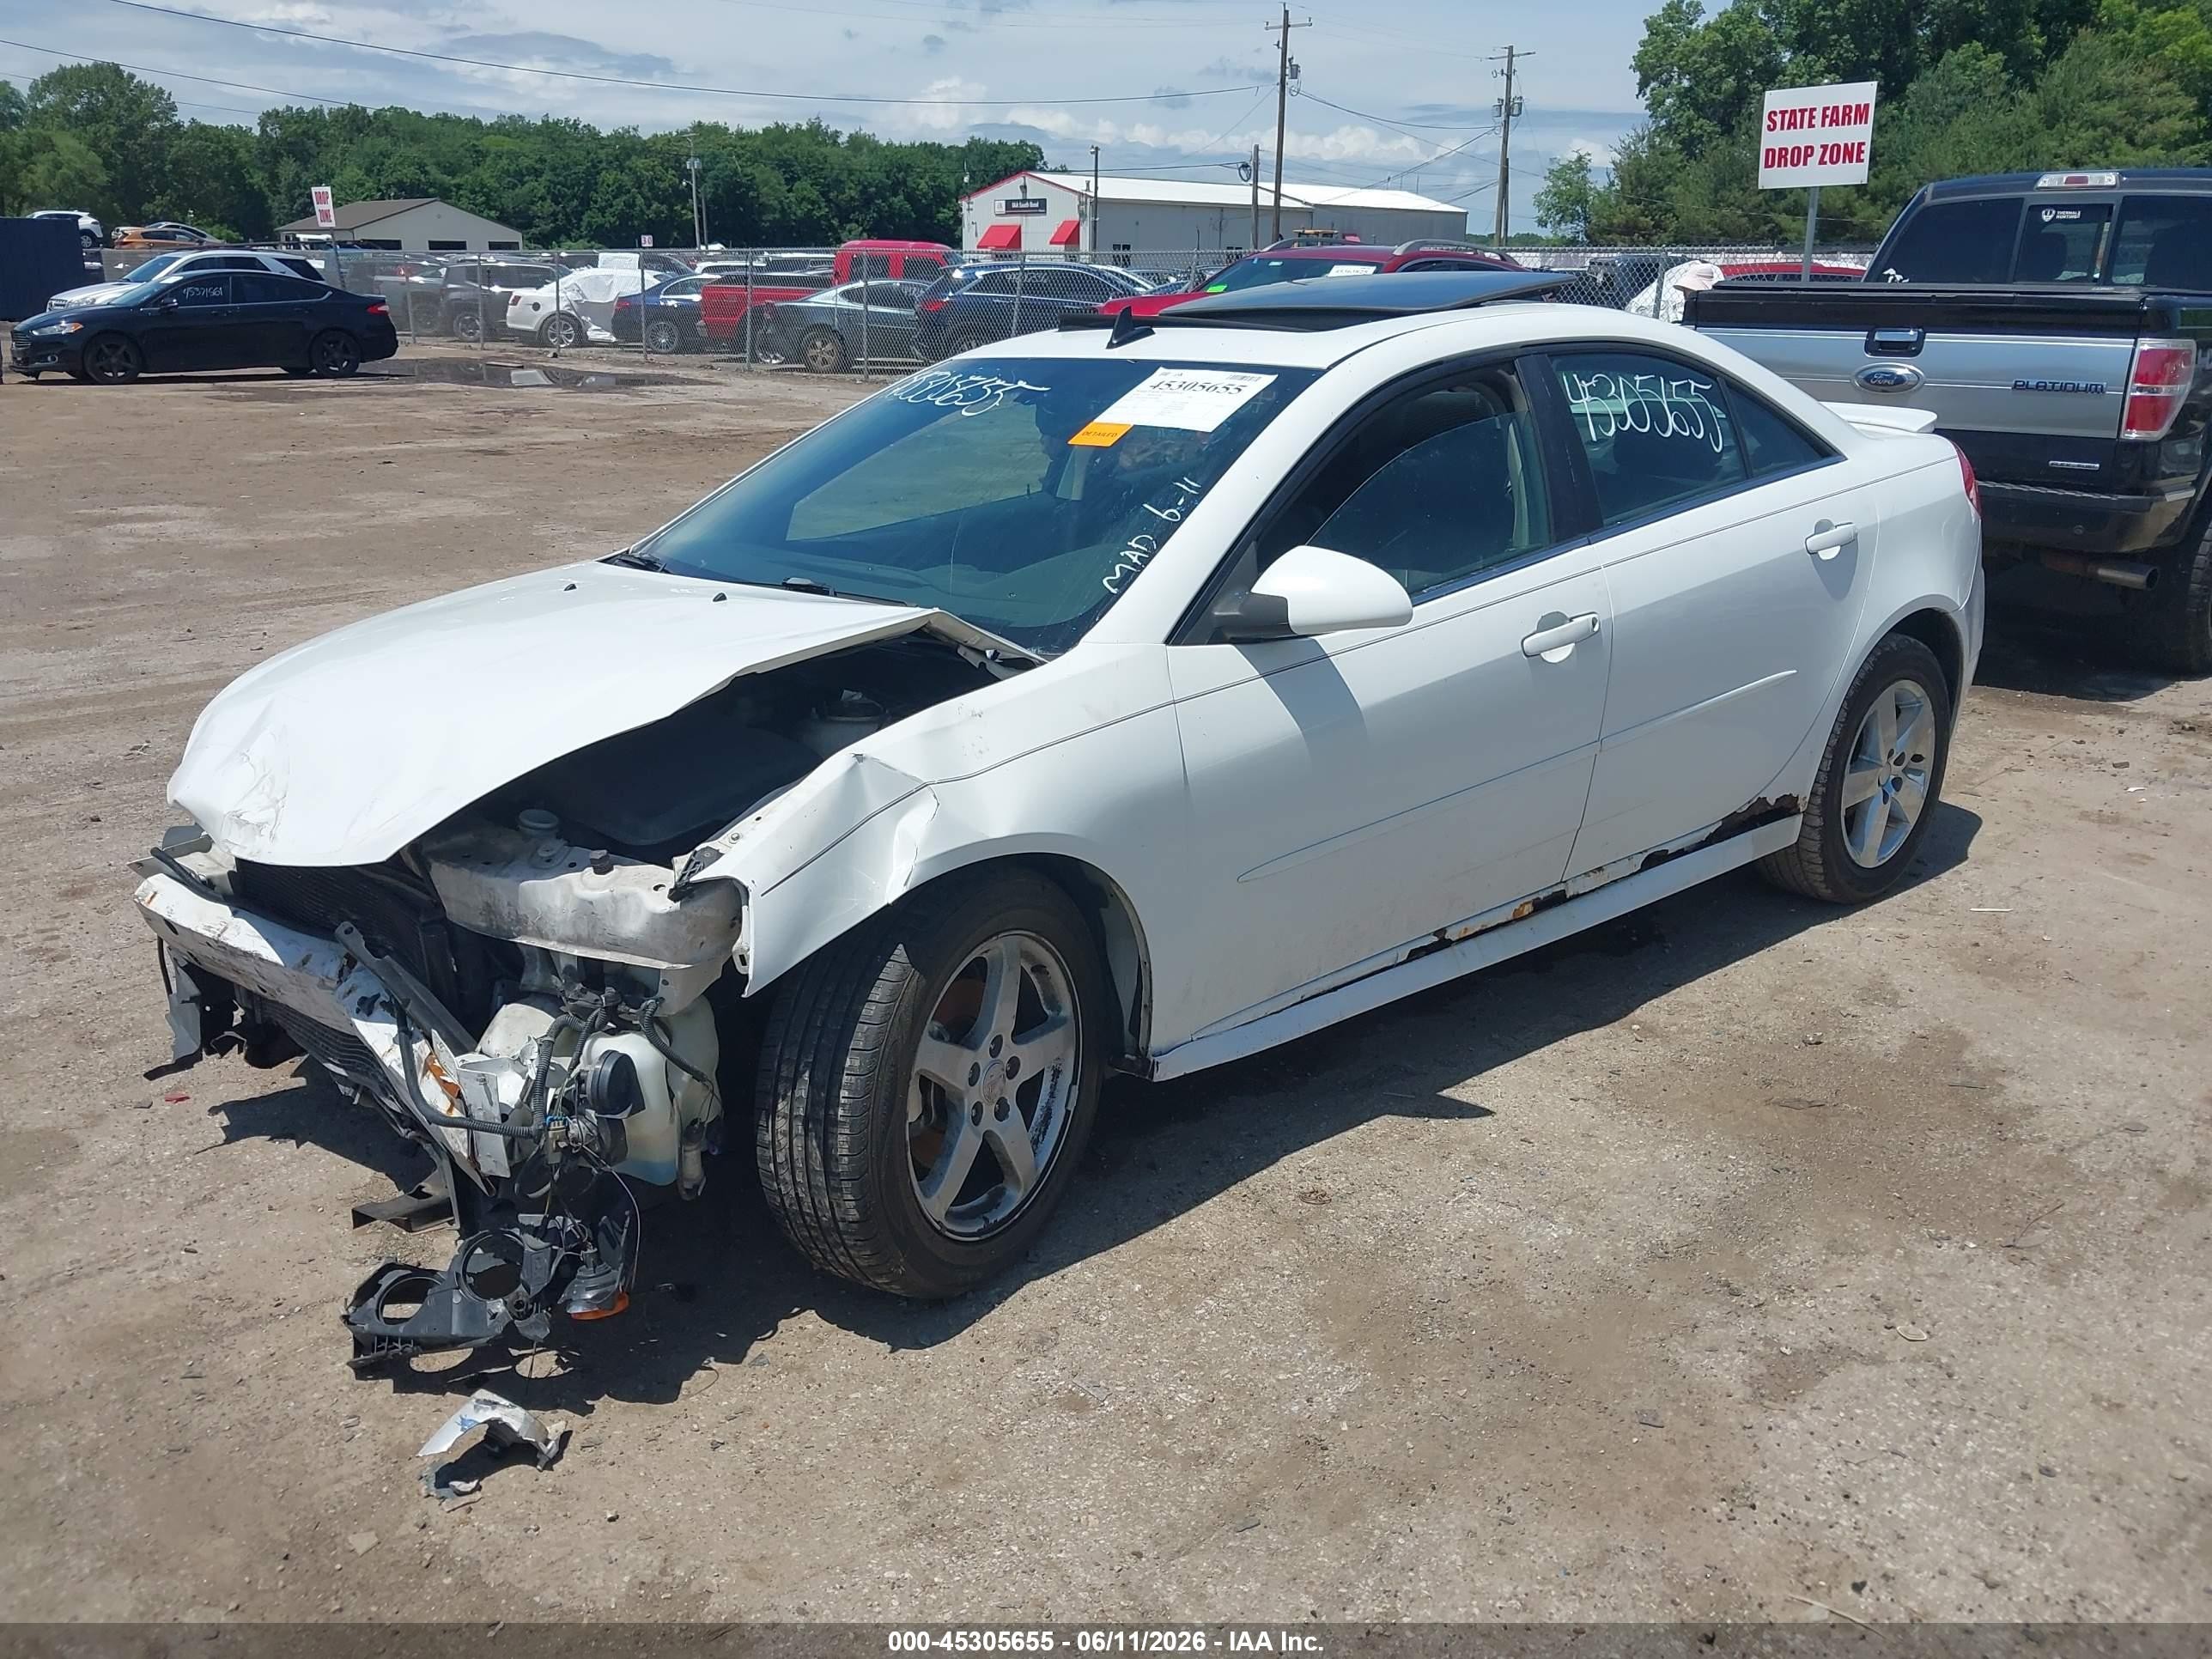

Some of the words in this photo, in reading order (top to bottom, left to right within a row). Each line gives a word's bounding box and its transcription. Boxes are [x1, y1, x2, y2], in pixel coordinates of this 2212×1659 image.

[1766, 107, 1817, 132] STATE
[1820, 102, 1870, 128] FARM
[1764, 145, 1814, 169] DROP
[1818, 142, 1866, 166] ZONE
[314, 191, 330, 205] DROP
[318, 209, 332, 222] ZONE
[1869, 373, 1897, 386] Ford
[1150, 380, 1248, 395] 45305655
[2012, 380, 2105, 394] PLATINUM
